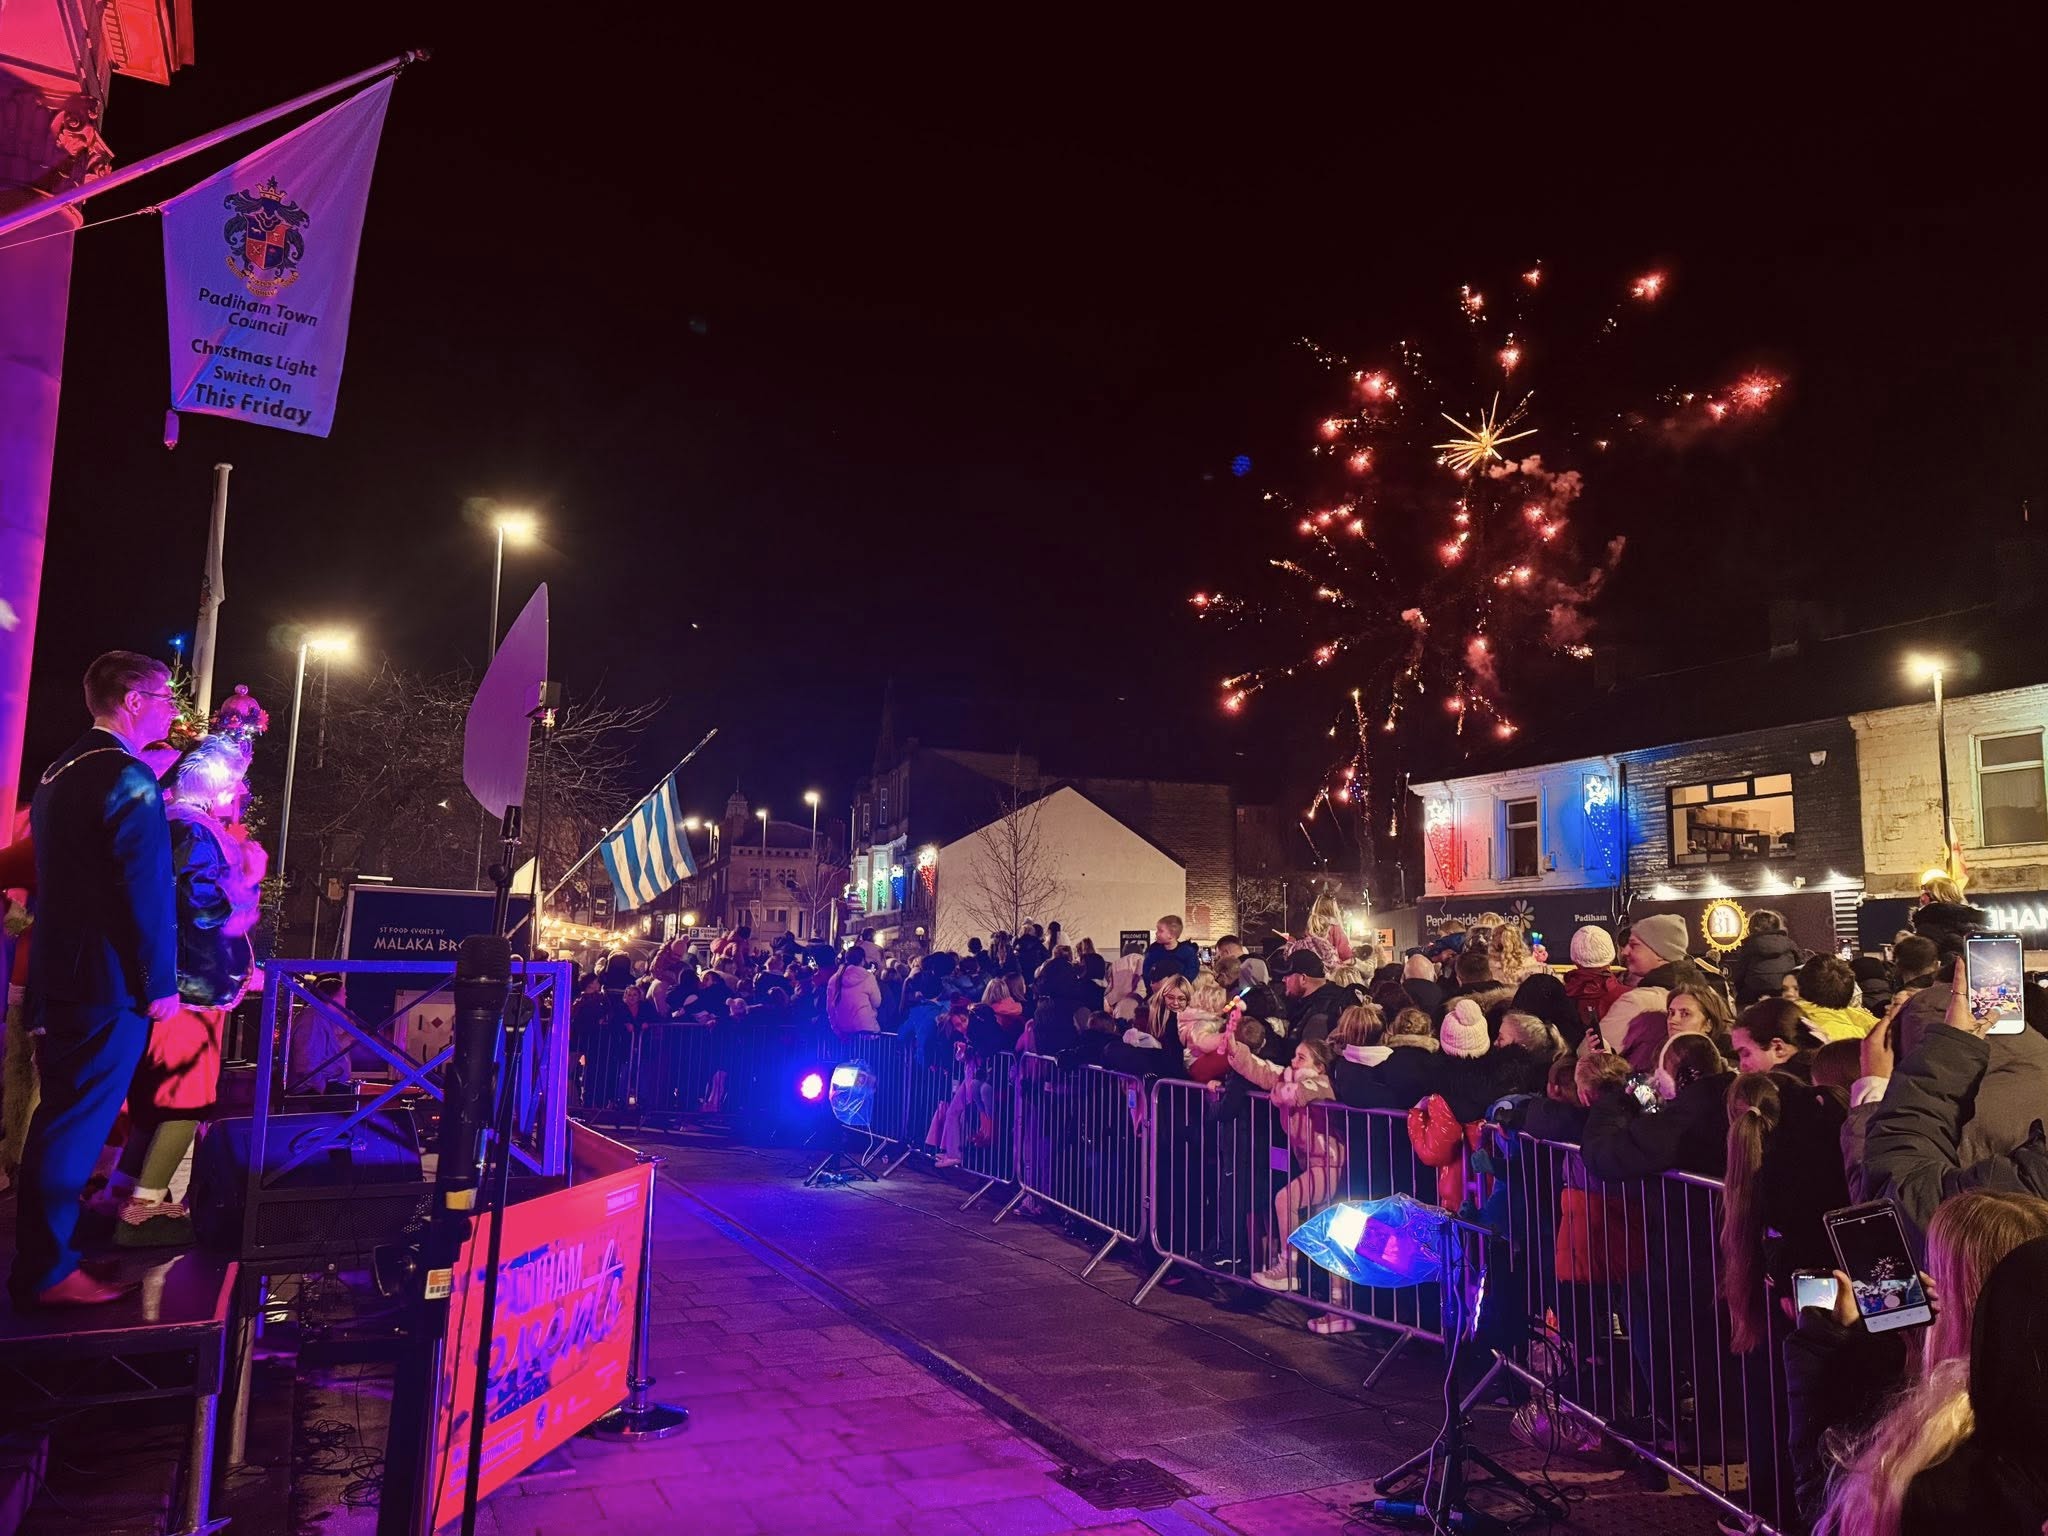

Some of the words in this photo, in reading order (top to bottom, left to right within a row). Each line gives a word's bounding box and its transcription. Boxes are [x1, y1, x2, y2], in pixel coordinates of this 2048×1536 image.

[198, 287, 271, 315] Padiham
[277, 303, 318, 327] Town
[228, 312, 288, 336] Council
[276, 355, 317, 377] Light
[214, 365, 265, 388] Switch
[269, 377, 292, 394] On
[196, 383, 235, 408] This
[240, 394, 313, 426] Friday
[1574, 914, 1608, 922] Padiham
[389, 926, 408, 934] FOOD
[410, 927, 434, 935] EVENTS
[374, 937, 434, 951] MALAKA
